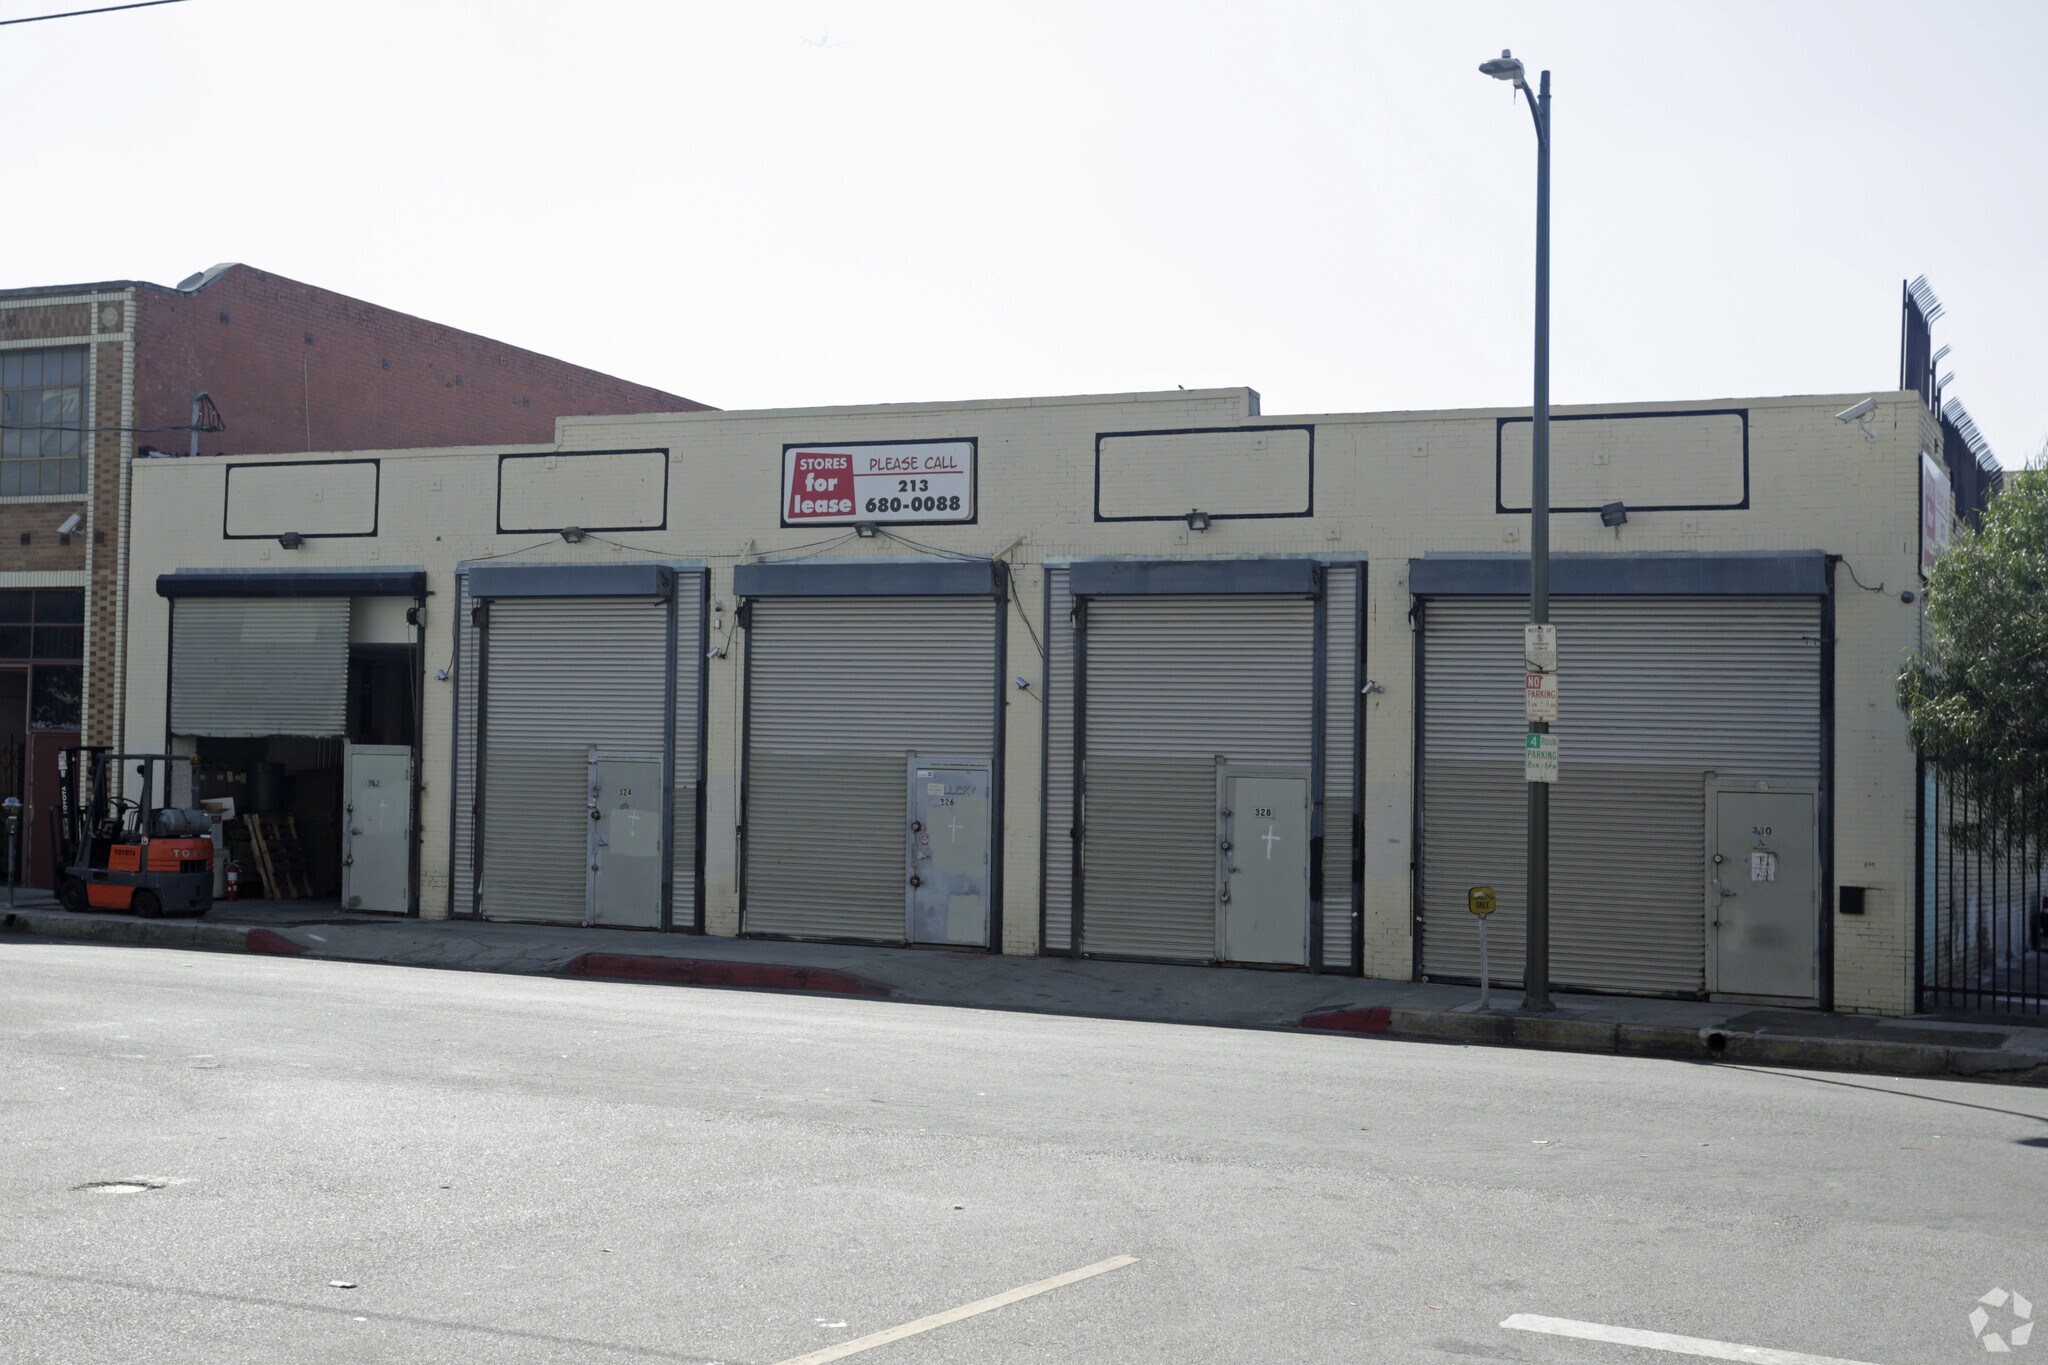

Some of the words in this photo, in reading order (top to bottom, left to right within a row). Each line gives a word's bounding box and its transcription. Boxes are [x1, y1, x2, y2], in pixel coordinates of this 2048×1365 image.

[800, 457, 848, 470] STORES
[869, 456, 918, 471] PLEASE
[924, 455, 958, 470] CALL
[805, 472, 838, 492] for
[898, 479, 929, 492] 213
[794, 494, 852, 514] lease
[865, 495, 961, 513] 680-0088
[1527, 676, 1540, 688] NO
[1527, 690, 1556, 699] PARKING
[1530, 736, 1538, 747] 4
[1527, 750, 1557, 760] PARKING
[1255, 808, 1272, 816] 328
[114, 849, 136, 857] TOYOTA
[1475, 901, 1490, 909] ONLY
